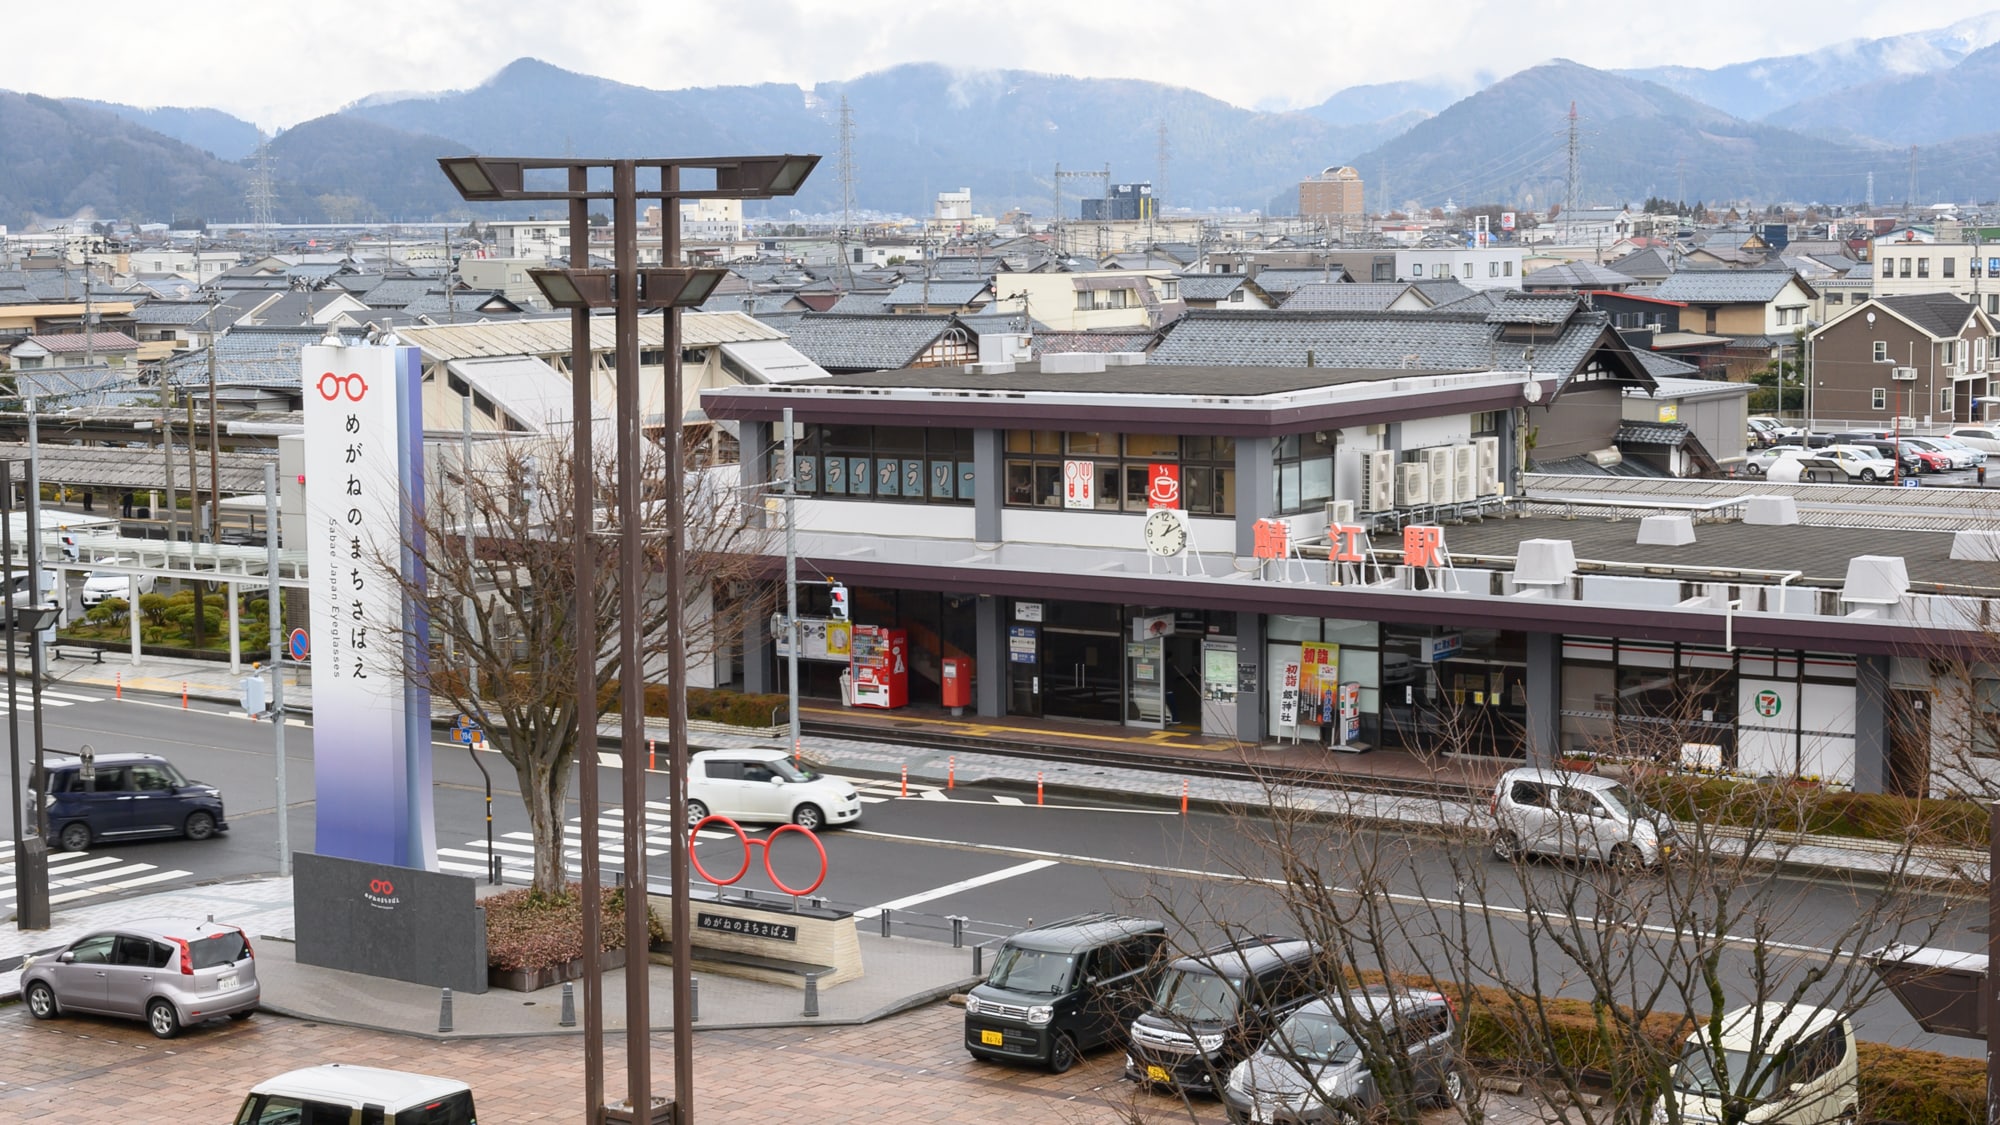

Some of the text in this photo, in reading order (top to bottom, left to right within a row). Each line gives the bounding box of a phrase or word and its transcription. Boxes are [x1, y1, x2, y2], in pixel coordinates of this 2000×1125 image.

[1161, 512, 1169, 521] 12
[1147, 528, 1153, 538] 9
[1252, 518, 1444, 567] 鯖江駅
[345, 413, 367, 679] めがねのまちさばえ
[1162, 545, 1169, 555] 6
[329, 518, 341, 678] Sabae Japan Eyeglasses
[1285, 664, 1298, 687] 初詣
[704, 917, 790, 939] めがねのまちさばえ
